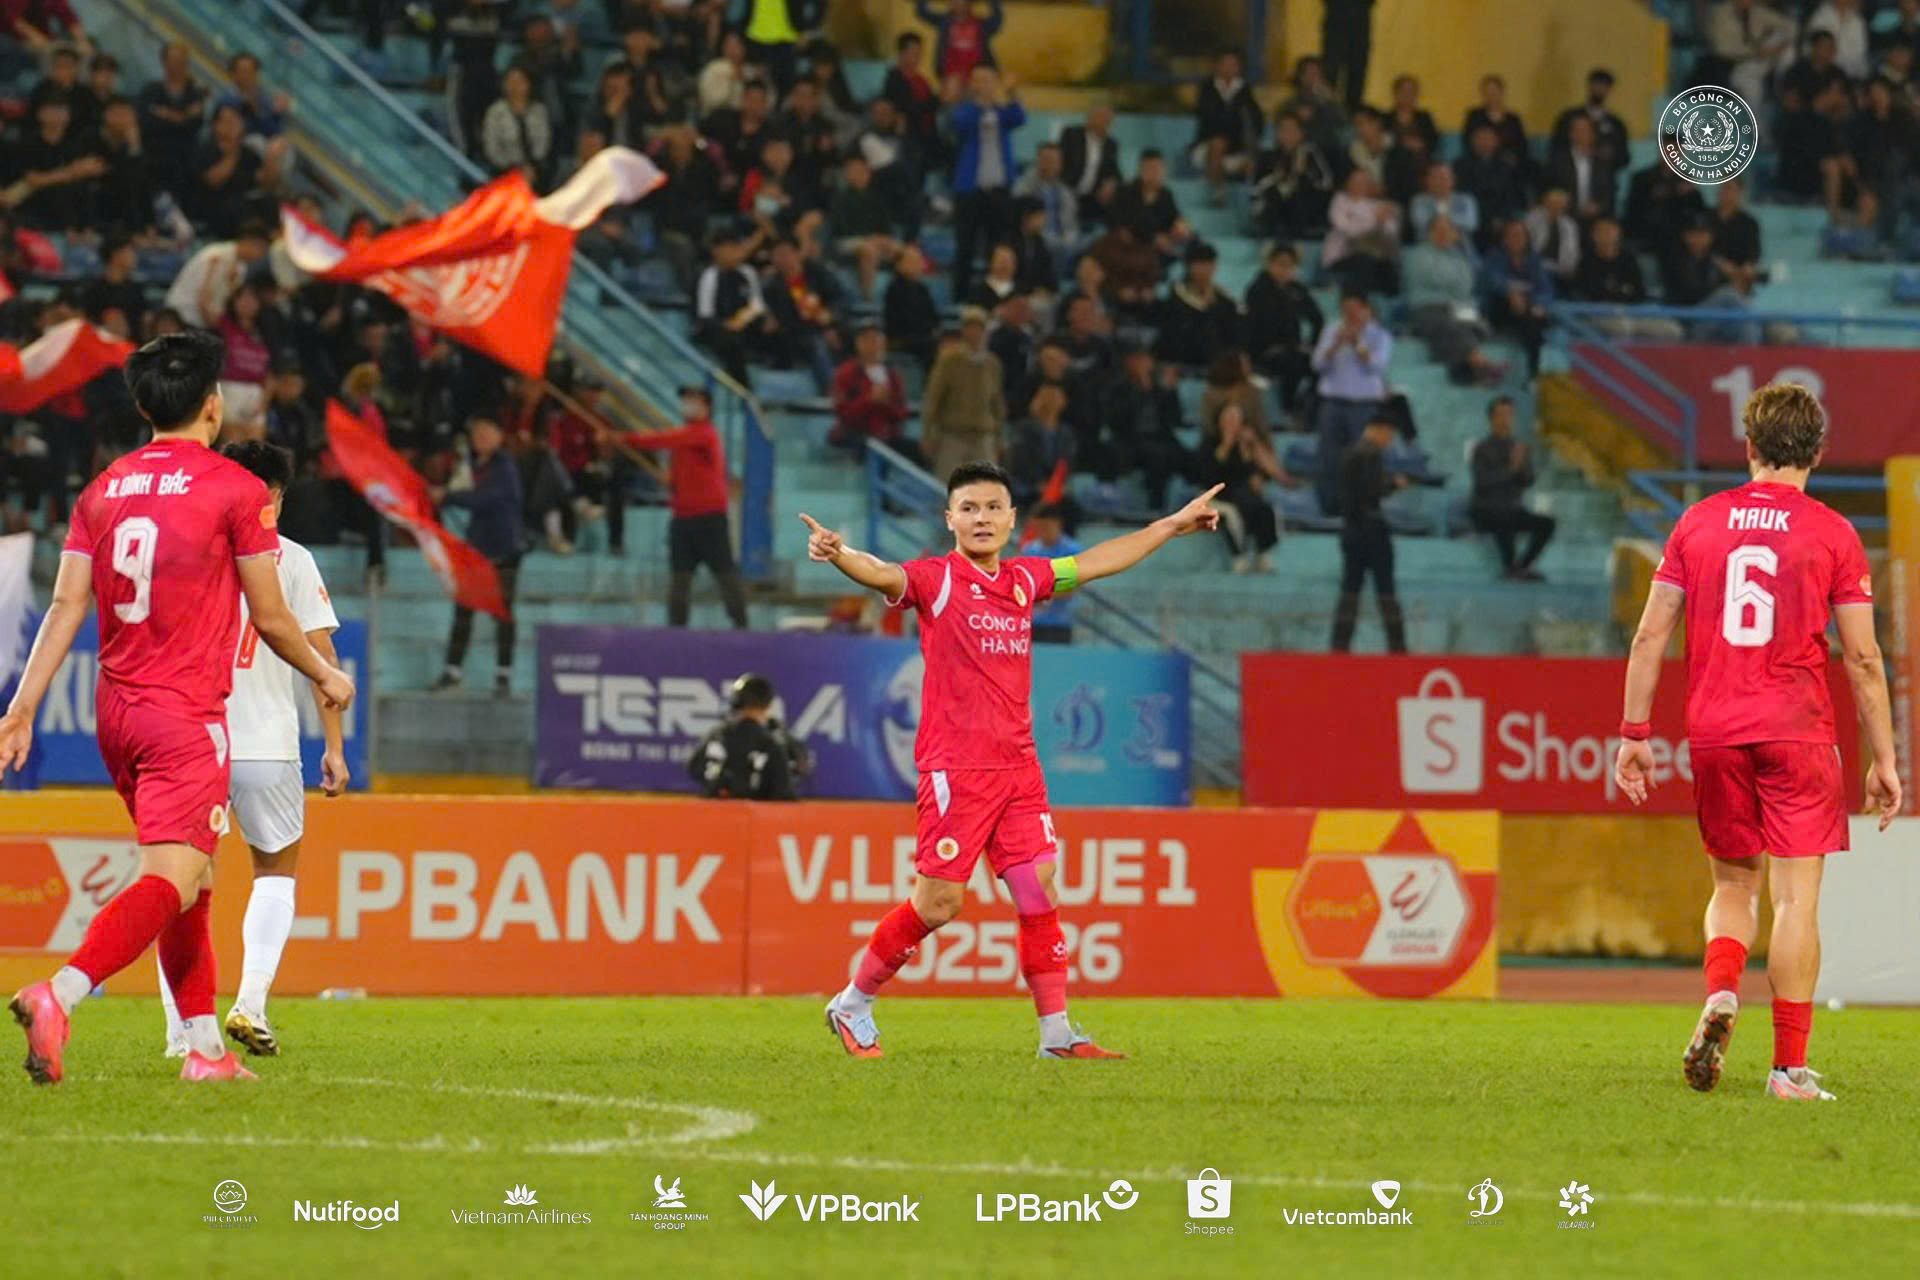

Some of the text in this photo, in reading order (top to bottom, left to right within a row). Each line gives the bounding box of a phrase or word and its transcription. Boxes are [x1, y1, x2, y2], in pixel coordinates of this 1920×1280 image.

[1728, 507, 1791, 532] MAUK
[112, 516, 159, 625] 9
[1722, 544, 1778, 648] 6
[553, 673, 847, 743] TERA
[1425, 713, 1459, 777] S
[1157, 838, 1197, 905] 1
